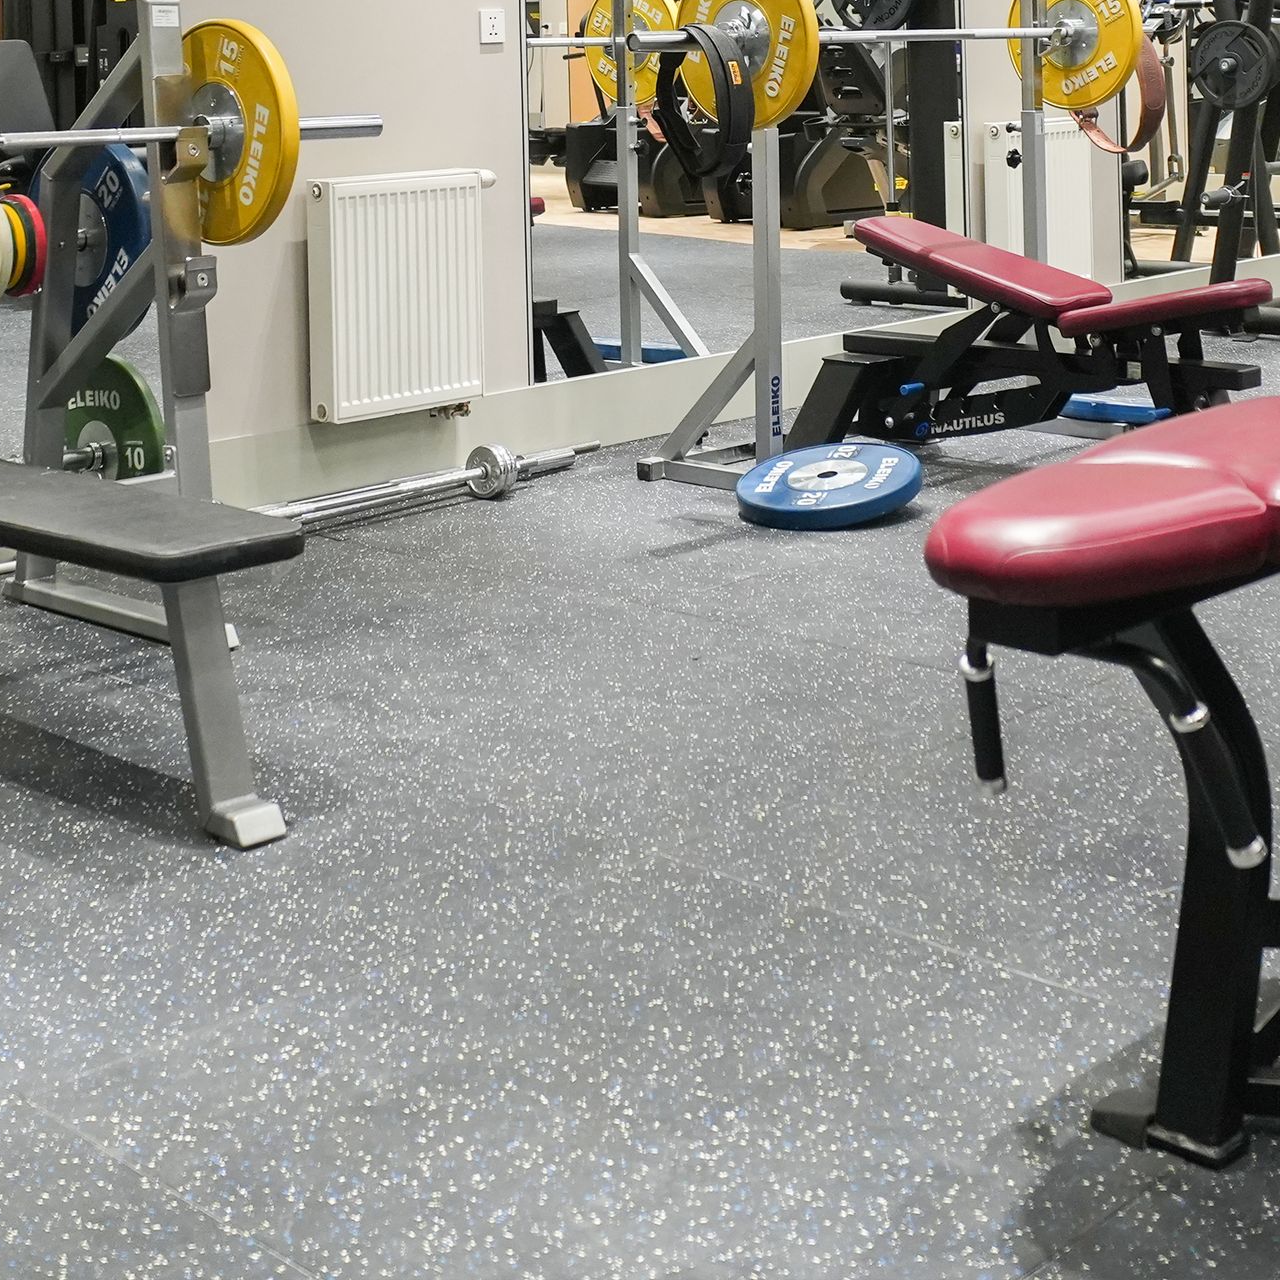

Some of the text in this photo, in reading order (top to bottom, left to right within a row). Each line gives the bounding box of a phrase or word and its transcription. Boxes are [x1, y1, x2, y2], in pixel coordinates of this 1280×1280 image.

[219, 38, 239, 78] 15
[765, 14, 796, 99] ELEIKO
[1061, 51, 1118, 95] ELEIKO
[239, 103, 270, 207] ELEIKO
[97, 170, 120, 208] 20
[86, 247, 130, 320] ELEIKO
[67, 389, 121, 411] ELEIKO
[771, 375, 782, 438] ELEIKO
[930, 411, 1006, 435] NAUTILUS
[125, 446, 145, 470] 10
[833, 445, 857, 460] 20
[755, 460, 794, 493] ELEIKO
[864, 457, 900, 490] ELEIKO
[797, 491, 822, 506] 20
